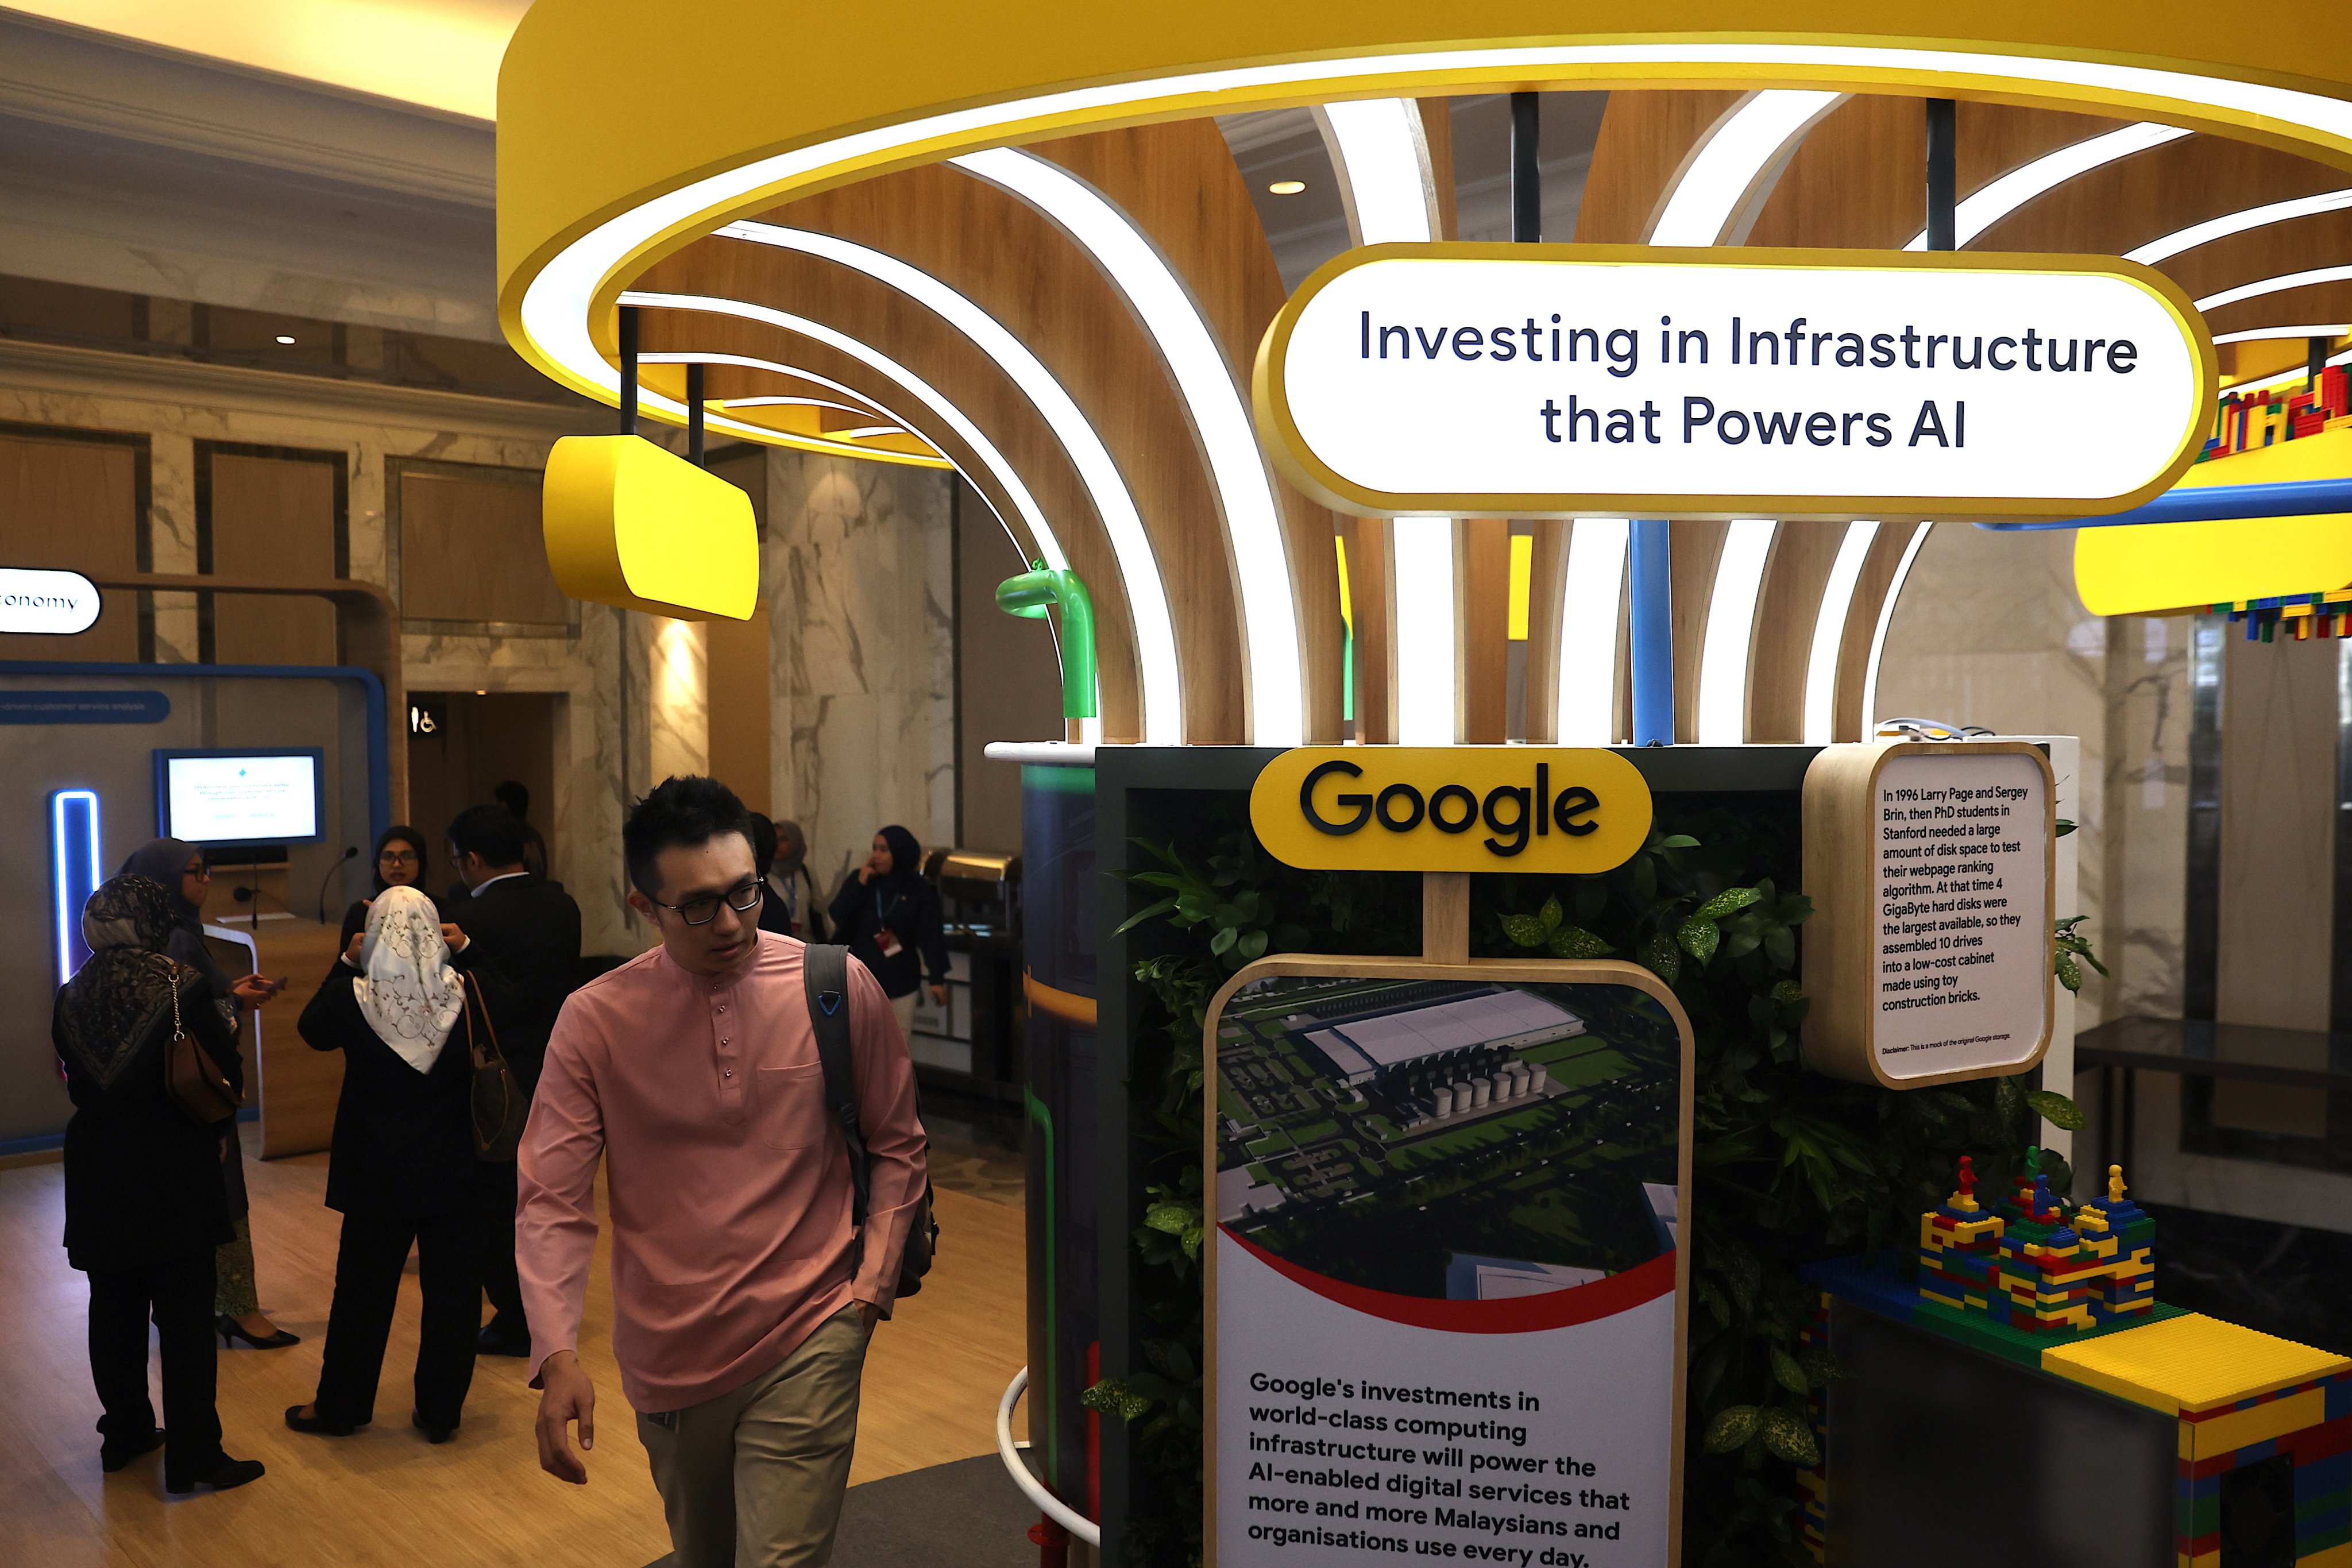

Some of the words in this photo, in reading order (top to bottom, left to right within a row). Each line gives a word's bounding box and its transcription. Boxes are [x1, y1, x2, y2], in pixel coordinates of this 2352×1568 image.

[1362, 311, 1637, 377] Investing
[1661, 315, 1708, 364] in
[1732, 317, 2137, 374] Infrastructure
[1540, 395, 1660, 444] that
[1684, 396, 1892, 447] Powers
[1908, 400, 1964, 447] AI
[0, 595, 78, 612] onomy
[1884, 789, 1893, 802] In
[1895, 789, 1918, 801] 1996
[1921, 788, 1947, 803] Larry
[1949, 787, 1973, 802] Page
[1975, 786, 1994, 799] and
[1995, 786, 2028, 801] Sergey
[1300, 760, 1600, 858] Google
[1884, 808, 1906, 821] Brin,
[1909, 808, 1932, 820] then
[1934, 806, 1955, 818] PhD
[1957, 805, 1999, 818] students
[2001, 804, 2010, 816] in
[1883, 825, 1926, 840] Stanford
[1929, 824, 1966, 837] needed
[1968, 827, 1974, 836] a
[1976, 823, 2000, 838] large
[1883, 846, 1922, 859] amount
[1924, 844, 1935, 857] of
[1937, 843, 1957, 856] disk
[1959, 844, 1988, 858] space
[1990, 842, 2000, 853] to
[2002, 841, 2021, 852] test
[1883, 864, 1907, 878] their
[1909, 863, 1956, 878] webpage
[1957, 860, 1994, 875] ranking
[1883, 883, 1934, 900] algorithm.
[1936, 881, 1948, 894] At
[1950, 880, 1970, 893] that
[1972, 879, 1994, 891] time
[1996, 878, 2003, 889] 4
[1883, 902, 1930, 919] GigaByte
[1932, 899, 1955, 913] hard
[1957, 897, 1982, 910] disks
[1983, 898, 2007, 908] were
[1883, 922, 1900, 935] the
[1902, 920, 1937, 936] largest
[1939, 916, 1984, 930] available,
[1986, 917, 1998, 926] so
[1999, 913, 2021, 927] they
[1883, 937, 1937, 955] assembled
[1939, 937, 1951, 949] 10
[1953, 934, 1983, 948] drives
[1883, 961, 1902, 973] into
[1905, 962, 1910, 971] a
[1913, 955, 1956, 970] low-cost
[1958, 952, 1995, 965] cabinet
[1883, 978, 1911, 992] made
[1913, 975, 1940, 990] using
[1942, 975, 1958, 988] toy
[1882, 994, 1946, 1011] construction
[1948, 990, 1980, 1003] bricks.
[1882, 1046, 1910, 1055] Disclaimer:
[1957, 1037, 1975, 1045] original
[1975, 1035, 1992, 1043] Google
[1250, 1373, 1354, 1400] Google's
[1362, 1380, 1511, 1409] investments
[1519, 1391, 1539, 1411] in
[1249, 1406, 1388, 1431] world-class
[1395, 1419, 1526, 1446] computing
[1250, 1432, 1416, 1463] infrastructure
[1422, 1447, 1463, 1467] will
[1470, 1454, 1548, 1473] power
[1555, 1457, 1596, 1477] the
[1249, 1462, 1379, 1490] AI-enabled
[1387, 1474, 1461, 1499] digital
[1469, 1484, 1572, 1506] services
[1579, 1489, 1629, 1511] that
[1249, 1496, 1309, 1514] more
[1315, 1500, 1358, 1519] and
[1366, 1507, 1427, 1524] more
[1435, 1507, 1567, 1536] Malaysians
[1574, 1521, 1620, 1540] and
[1248, 1525, 1408, 1552] organisations
[1415, 1540, 1457, 1557] use
[1463, 1545, 1533, 1568] every
[1540, 1547, 1589, 1568] day.
